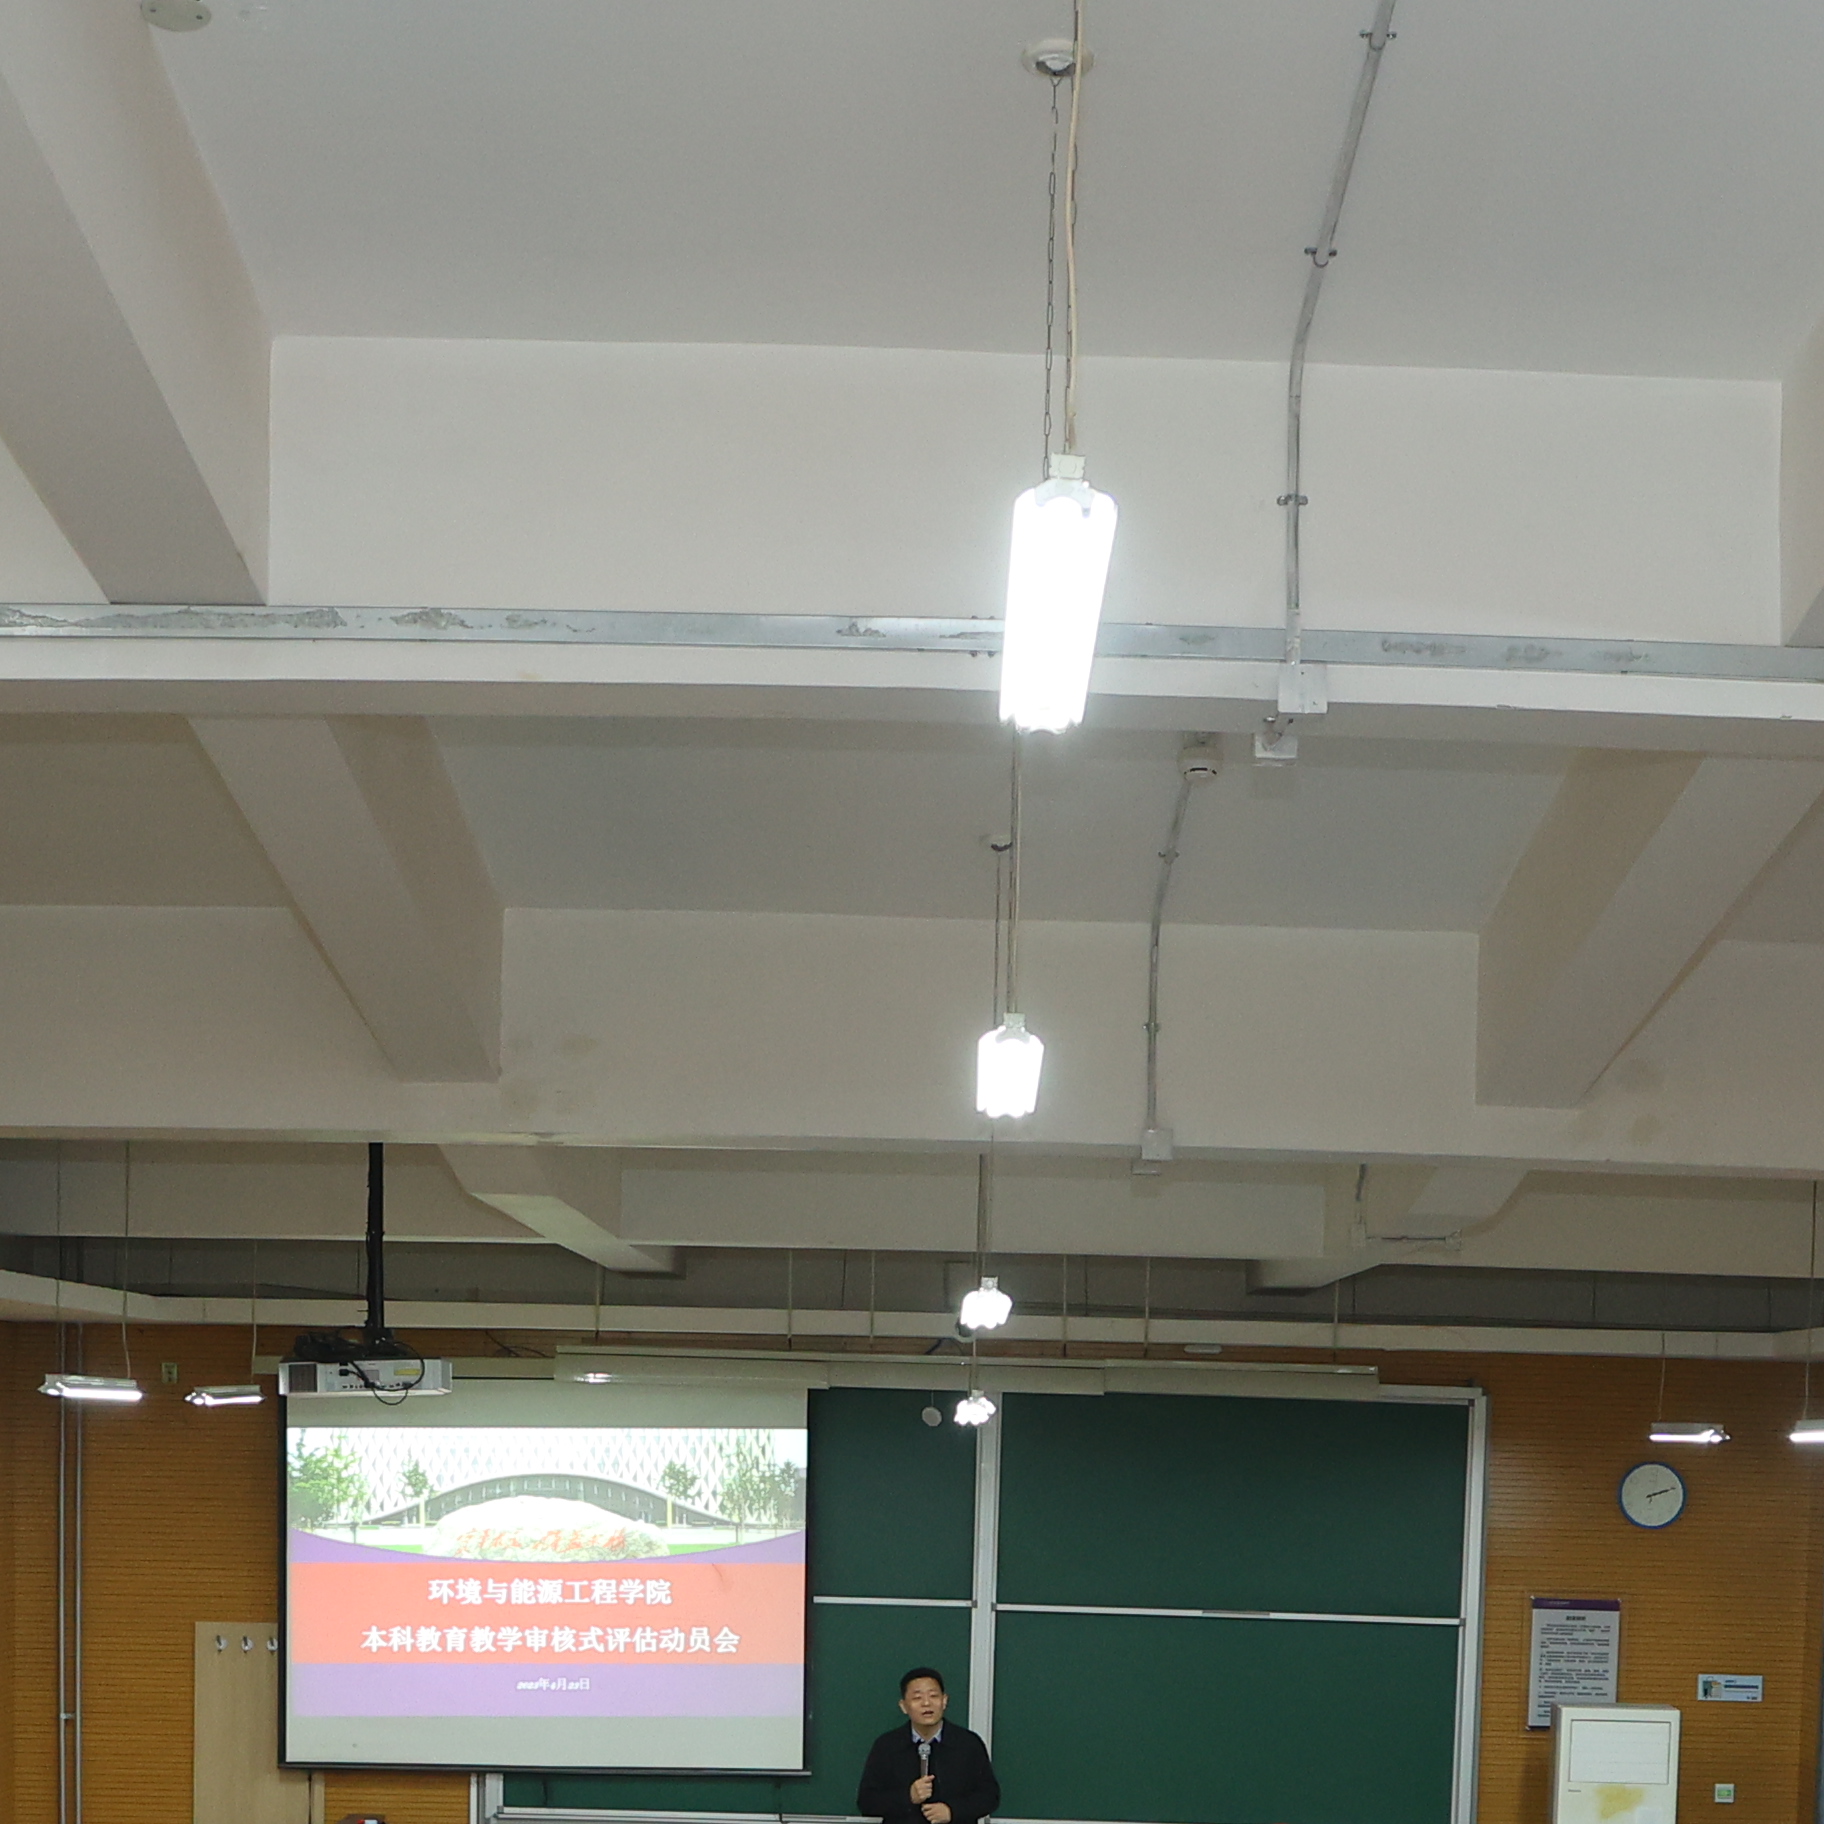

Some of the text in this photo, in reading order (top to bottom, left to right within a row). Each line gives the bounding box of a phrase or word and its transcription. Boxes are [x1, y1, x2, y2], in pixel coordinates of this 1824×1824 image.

[426, 1577, 673, 1605] 环境与能源工程学院
[360, 1624, 742, 1654] 本科教育教学审核式评估动员会
